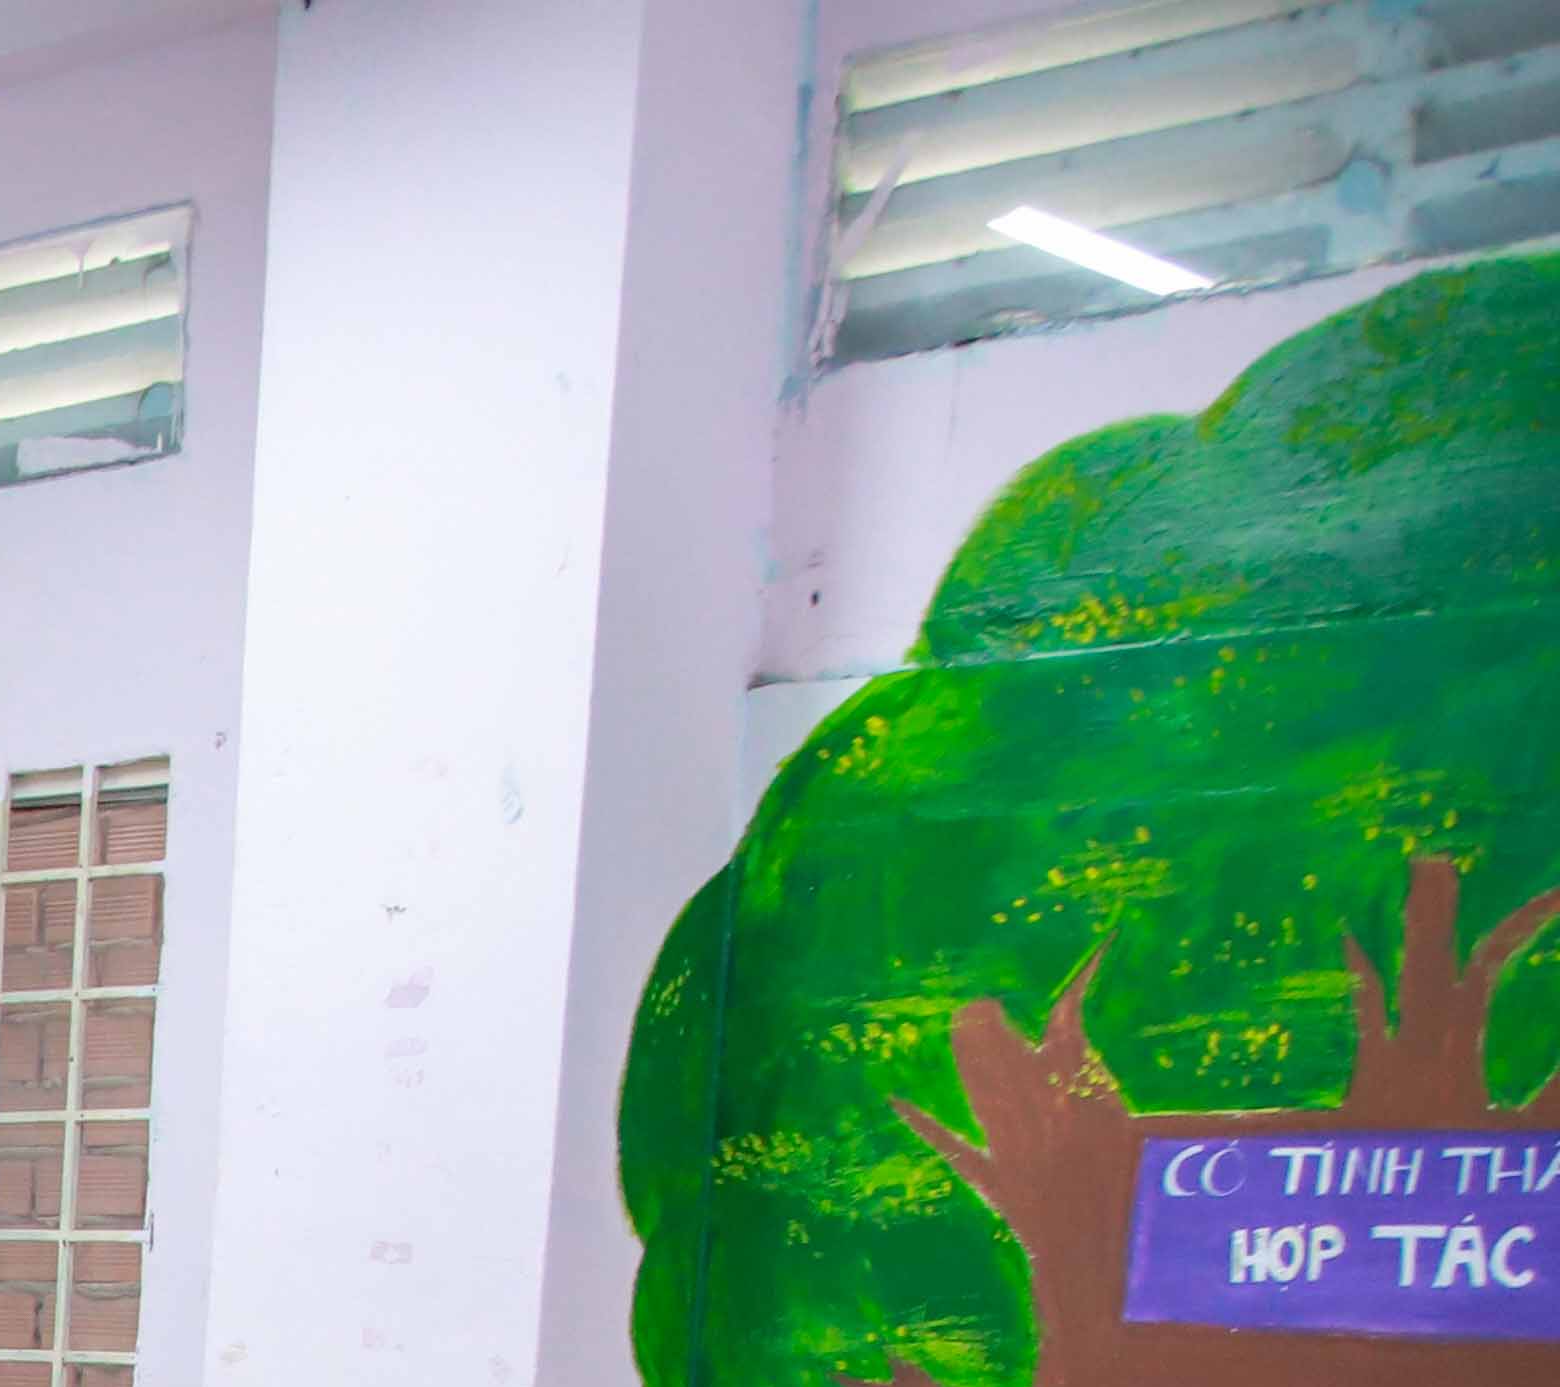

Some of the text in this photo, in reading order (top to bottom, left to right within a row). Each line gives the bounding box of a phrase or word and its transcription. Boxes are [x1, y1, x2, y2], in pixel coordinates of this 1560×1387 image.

[1162, 1138, 1250, 1198] CÓ
[1228, 1214, 1537, 1291] HỢP TÁC
